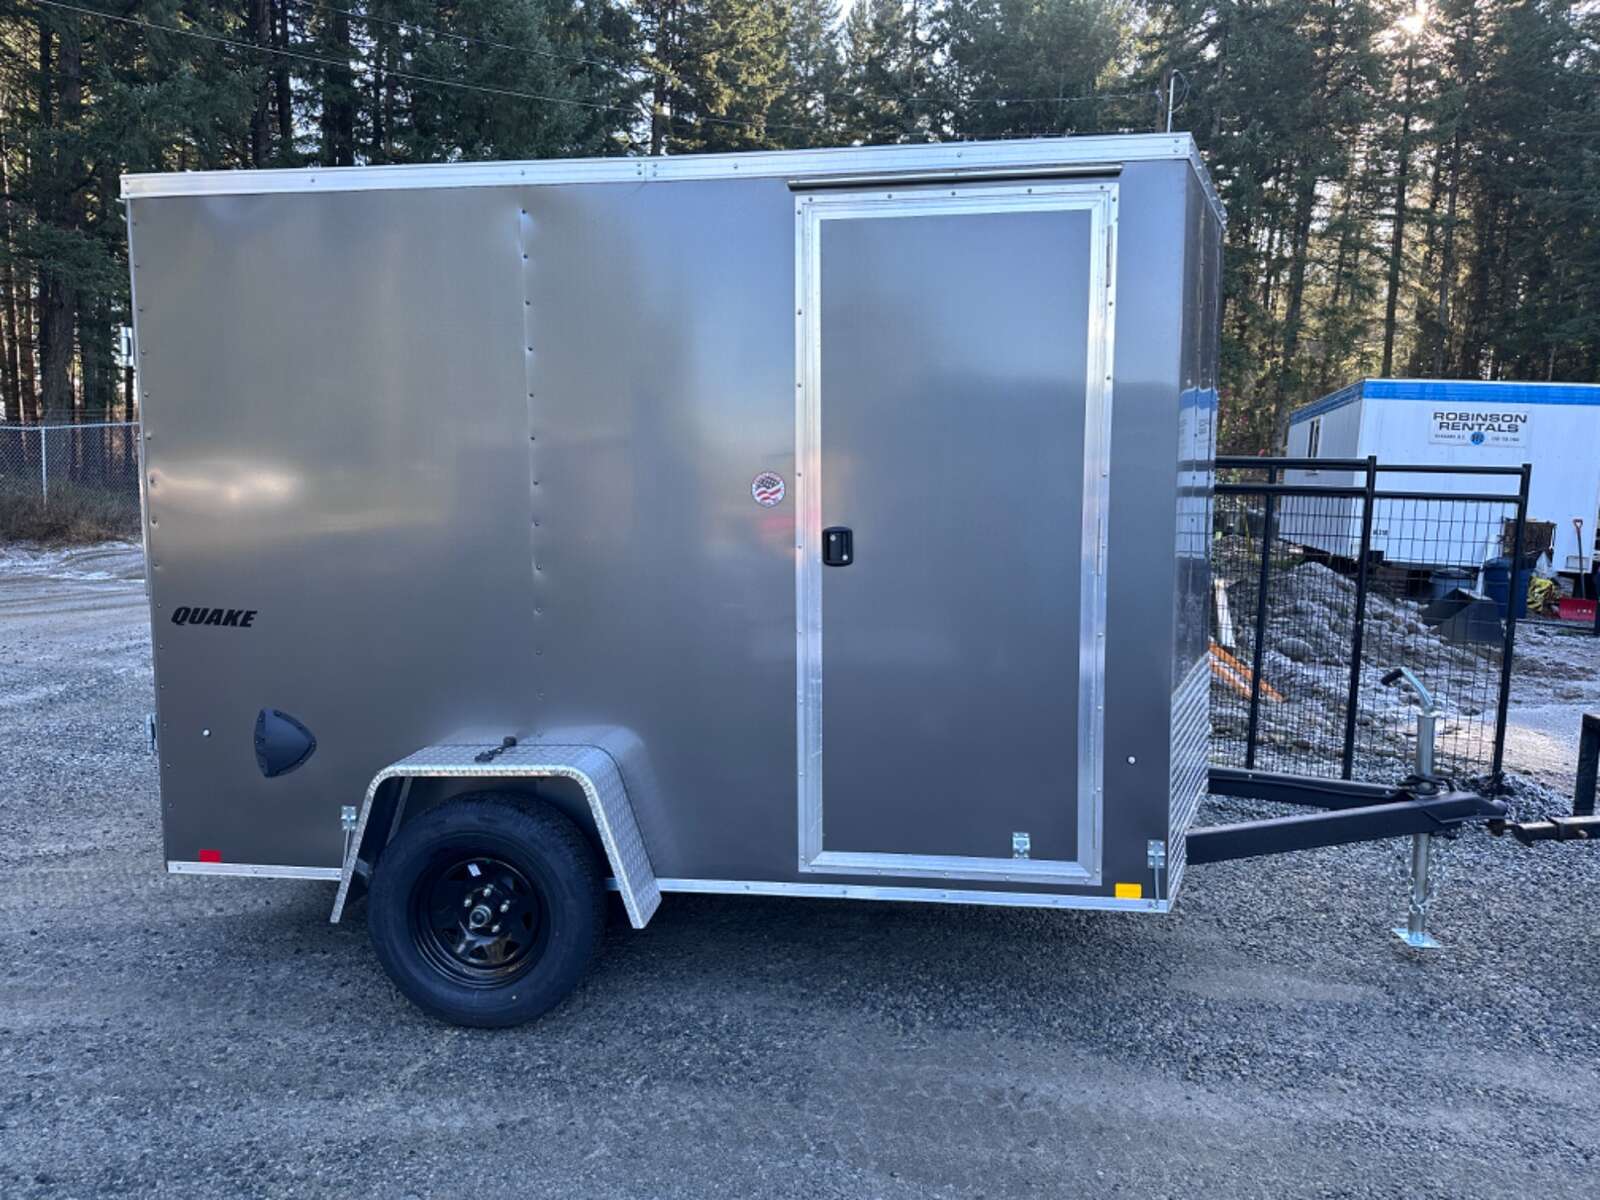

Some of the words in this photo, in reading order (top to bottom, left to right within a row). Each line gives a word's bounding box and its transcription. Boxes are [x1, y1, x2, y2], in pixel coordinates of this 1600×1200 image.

[1433, 412, 1527, 423] ROBINSON
[1439, 421, 1519, 433] RENTALS
[171, 606, 258, 627] QUAKE
